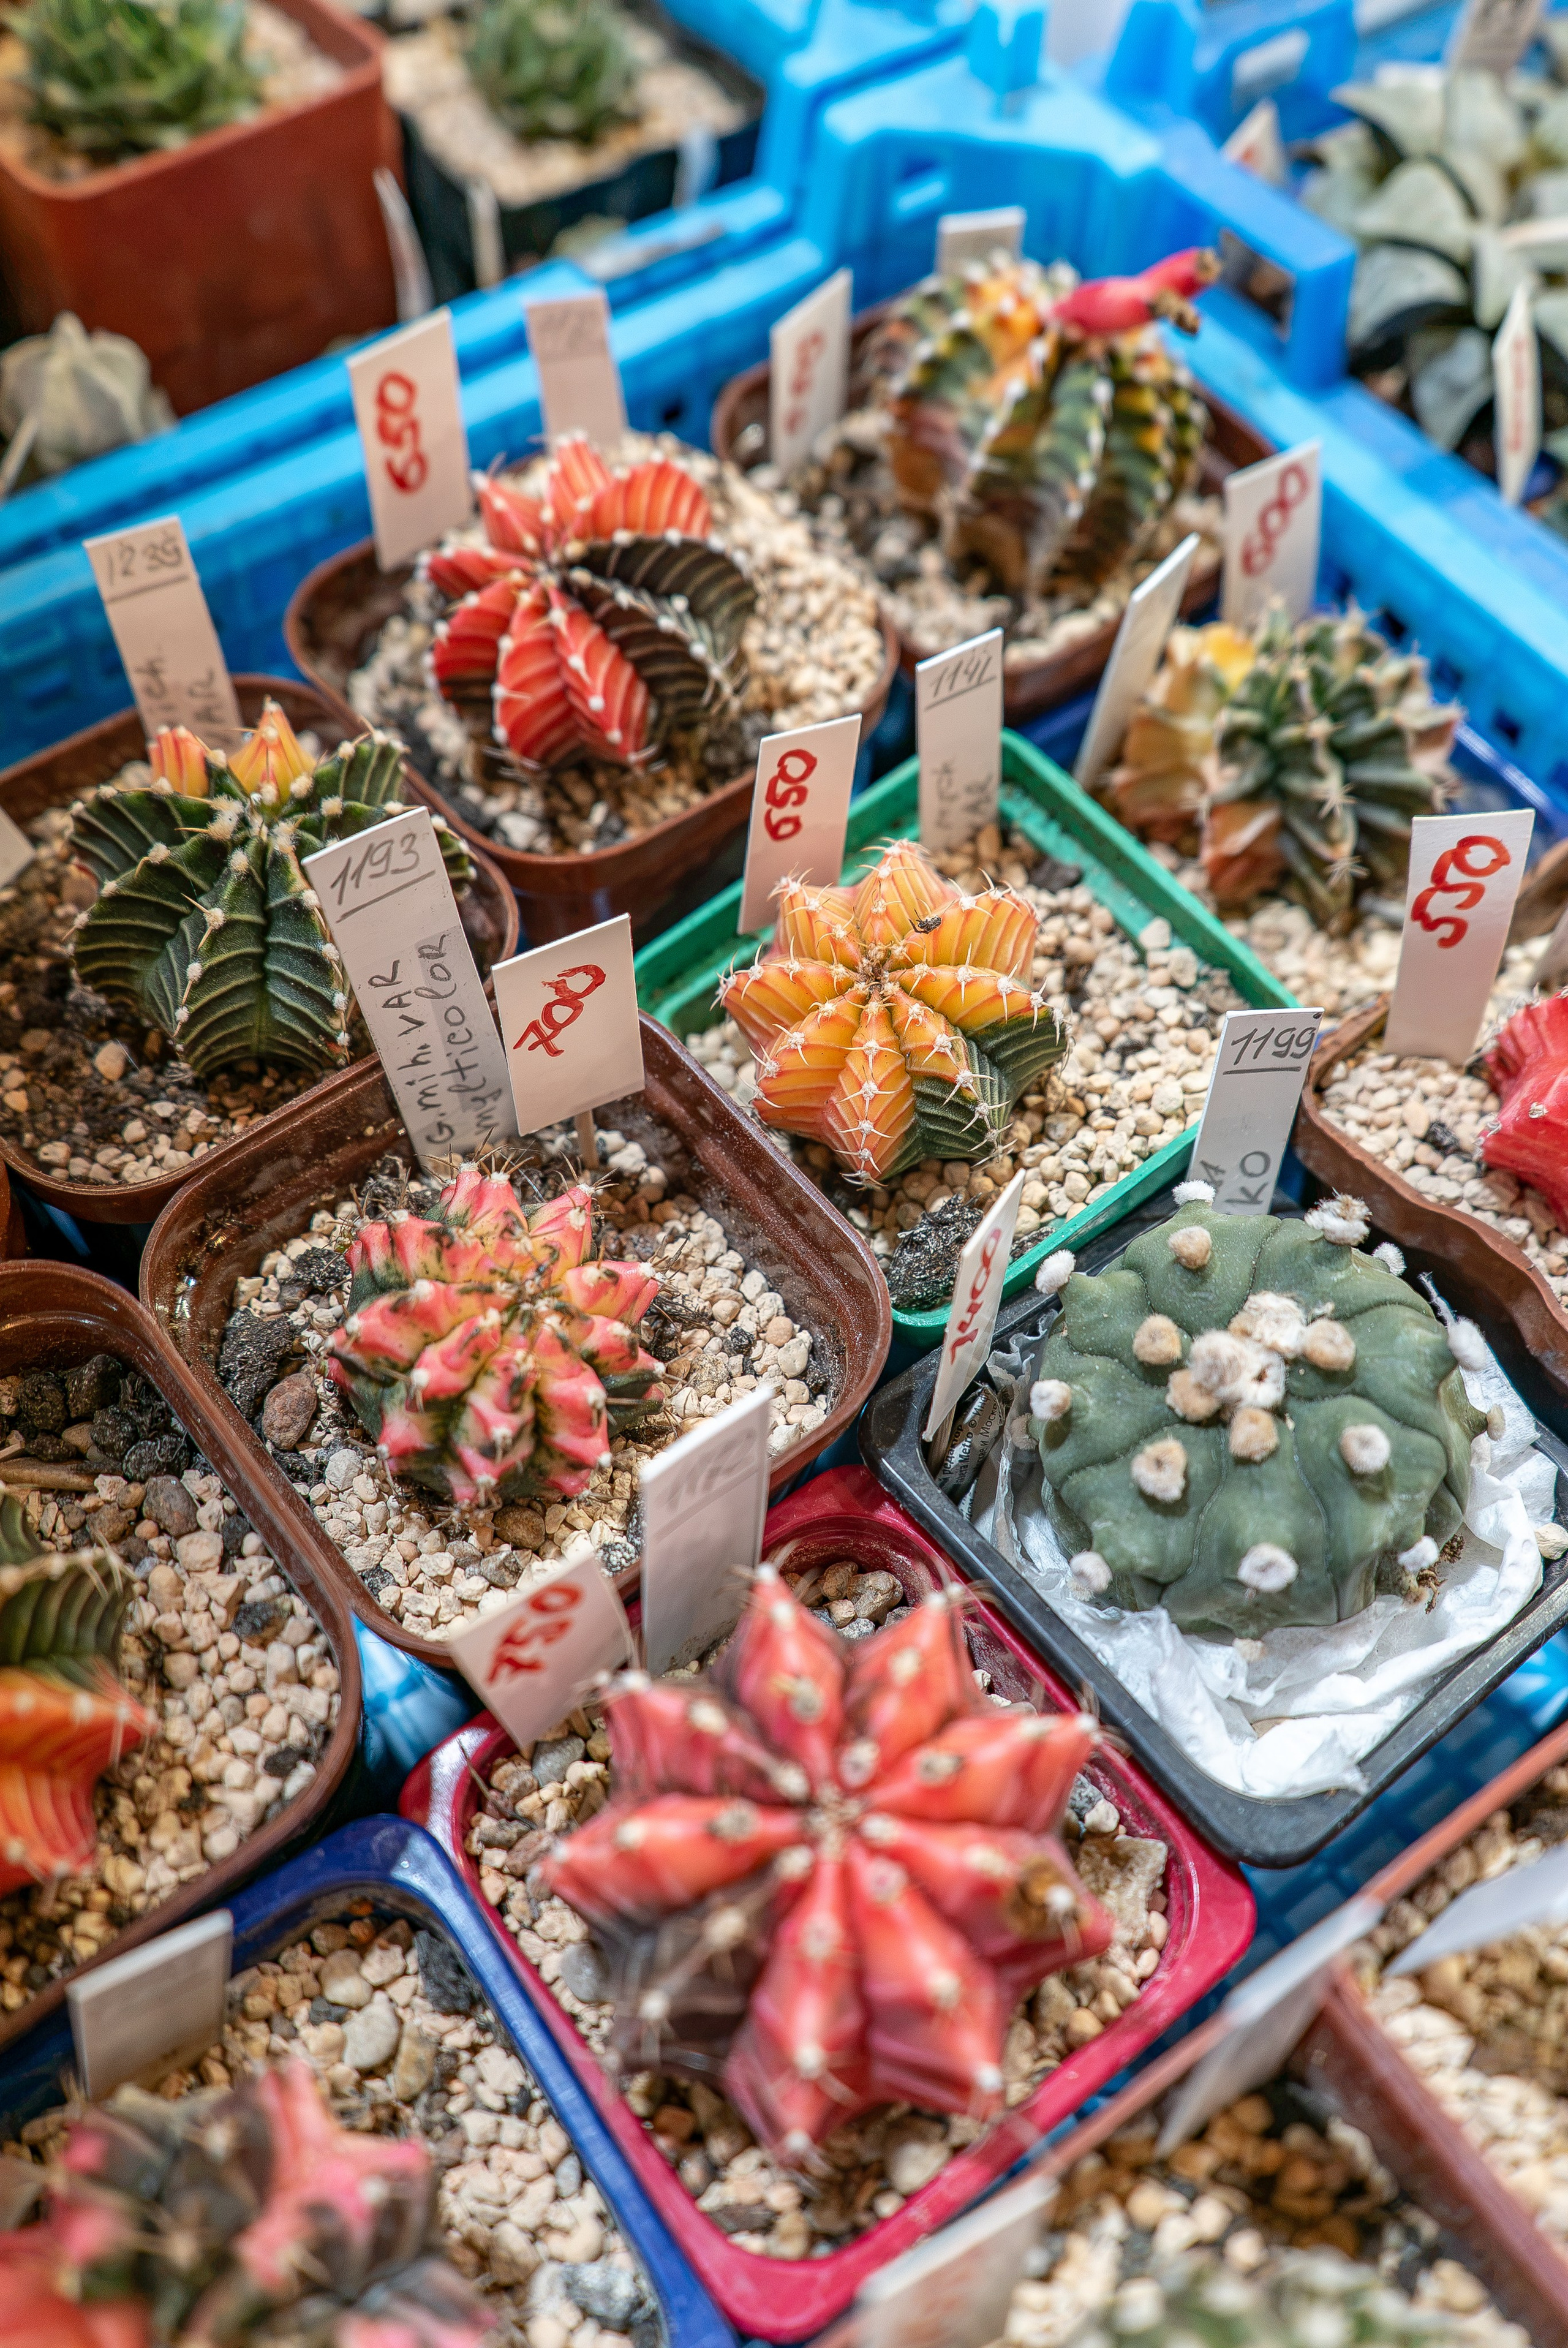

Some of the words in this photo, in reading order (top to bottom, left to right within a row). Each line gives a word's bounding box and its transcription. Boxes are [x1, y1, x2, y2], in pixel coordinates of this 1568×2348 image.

[375, 370, 428, 493] 650
[1240, 461, 1310, 577] 600
[763, 748, 818, 842] 650
[330, 833, 420, 905] 1193
[1411, 834, 1512, 949] 550
[513, 964, 606, 1057] 700
[1231, 1025, 1316, 1066] 1199
[958, 1431, 974, 1465] Metro
[487, 1580, 583, 1683] 750
